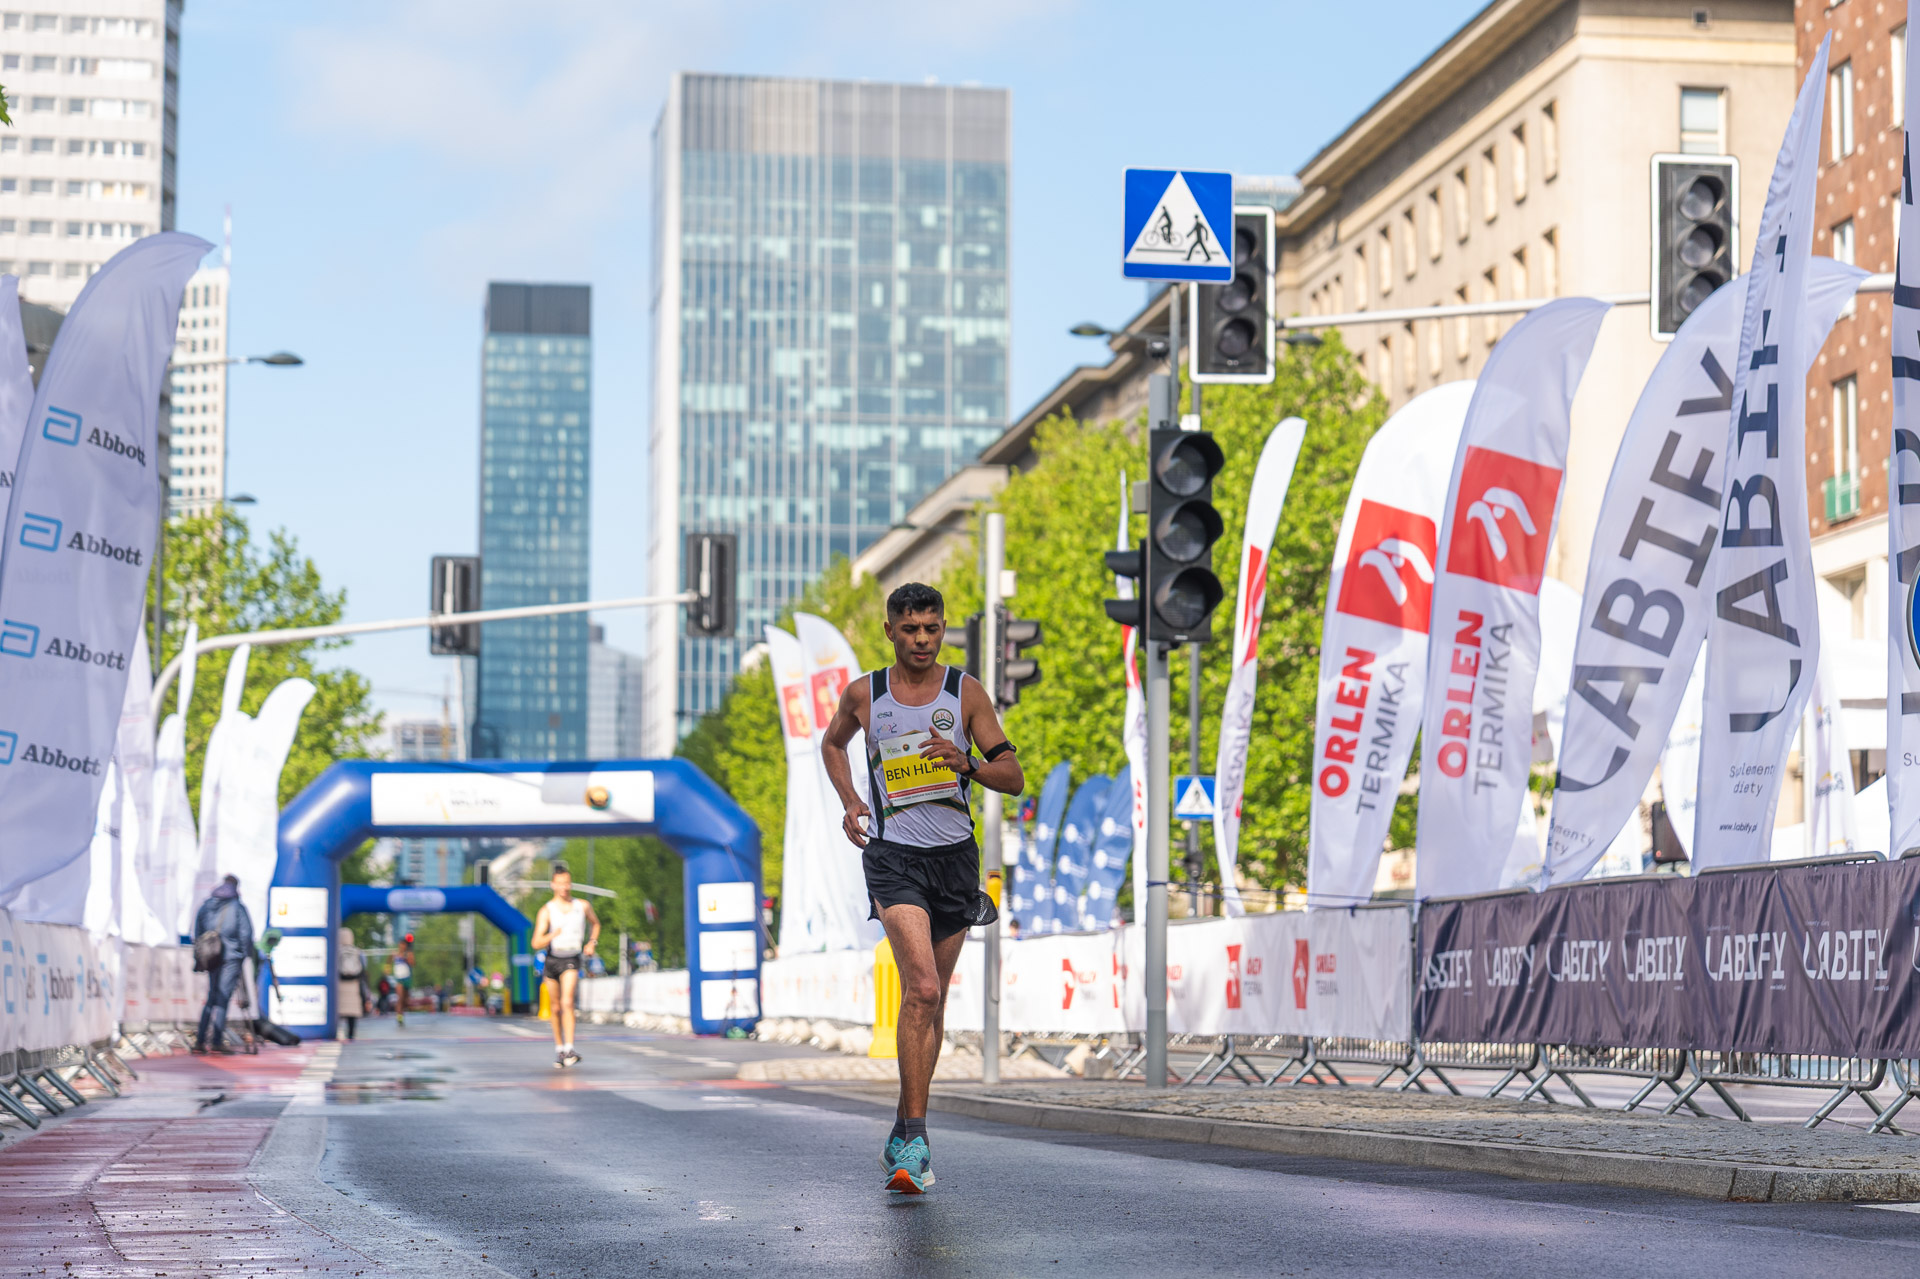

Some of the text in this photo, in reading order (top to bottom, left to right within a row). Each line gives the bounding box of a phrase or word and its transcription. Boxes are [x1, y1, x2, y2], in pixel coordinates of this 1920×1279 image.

[87, 427, 146, 467] Abbott
[67, 531, 143, 567] Abbott
[44, 637, 126, 671] Abbott
[1437, 608, 1484, 778] ORLEN
[1473, 622, 1514, 795] TERMIKA
[1318, 645, 1377, 798] ORLEN
[1356, 661, 1410, 815] TERMIKA
[21, 743, 101, 776] Abbott
[886, 766, 910, 782] BEN
[1733, 780, 1763, 797] diety
[1545, 940, 1611, 982] LABIFY
[1622, 936, 1687, 982] LABIFY
[1705, 931, 1787, 981] LABIFY
[1803, 928, 1889, 981] LABIFY
